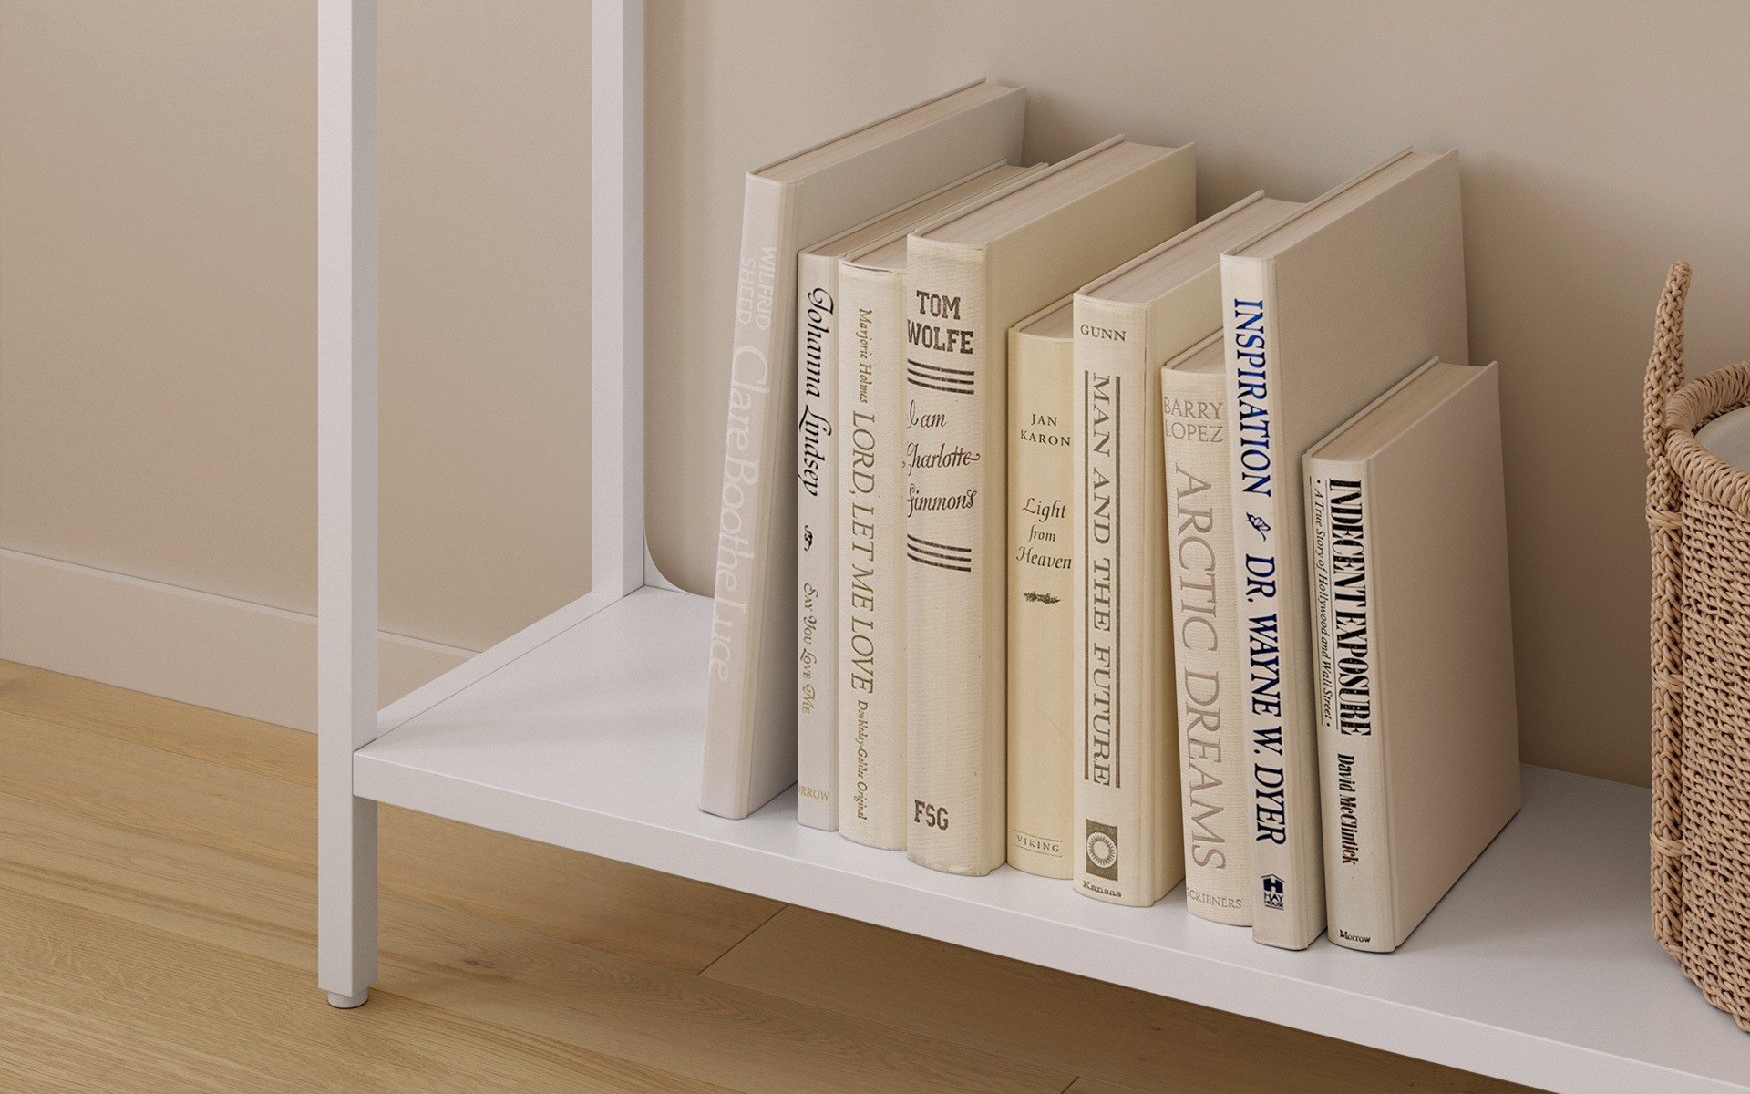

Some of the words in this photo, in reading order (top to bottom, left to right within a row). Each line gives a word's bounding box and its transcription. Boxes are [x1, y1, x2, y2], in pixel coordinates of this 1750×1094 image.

[755, 247, 777, 330] WILFRID
[916, 290, 961, 320] TOM
[806, 287, 834, 398] Johanna
[856, 308, 873, 360] Marjorie
[907, 319, 974, 355] WOLFE
[1080, 324, 1127, 342] GUNN
[727, 346, 769, 453] Clare
[920, 413, 947, 428] am
[1031, 413, 1058, 427] JAN
[1093, 372, 1111, 458] MAN
[1164, 396, 1224, 420] BARRY
[1233, 298, 1272, 498] INSPIRATION
[798, 405, 832, 497] Lindsey
[848, 409, 875, 496] LORD,
[1020, 429, 1071, 447] KARON
[1165, 420, 1224, 443] LOPEZ
[715, 459, 760, 592] Boothe
[1022, 497, 1067, 522] Light
[1093, 466, 1111, 545] AND
[1314, 500, 1324, 529] True
[851, 501, 875, 563] LET
[1027, 524, 1056, 543] from
[1175, 461, 1219, 652] ARCTIC
[1315, 530, 1325, 559] Story
[1330, 478, 1366, 607] INDECENT
[1016, 546, 1072, 570] Heaven
[1245, 553, 1277, 603] DR.
[1315, 559, 1325, 573] of
[850, 563, 875, 612] ME
[1093, 557, 1111, 632] THE
[1318, 573, 1329, 638] Hollywood
[850, 615, 875, 694] LOVE
[1248, 613, 1282, 718] WAYNE
[1322, 660, 1333, 689] Wall
[1335, 609, 1372, 736] EXPOSURE
[1093, 643, 1111, 787] FUTURE
[1323, 689, 1333, 720] Street
[1253, 725, 1284, 756] W.
[1184, 667, 1227, 870] DREAMS
[1337, 753, 1355, 792] David
[853, 781, 868, 821] Original
[913, 799, 949, 831] FSG
[1254, 762, 1287, 846] DYER
[1016, 835, 1060, 853] VIKING
[1340, 794, 1359, 865] McClintick
[1082, 880, 1122, 897] Kansas
[1339, 929, 1371, 943] Morrow
